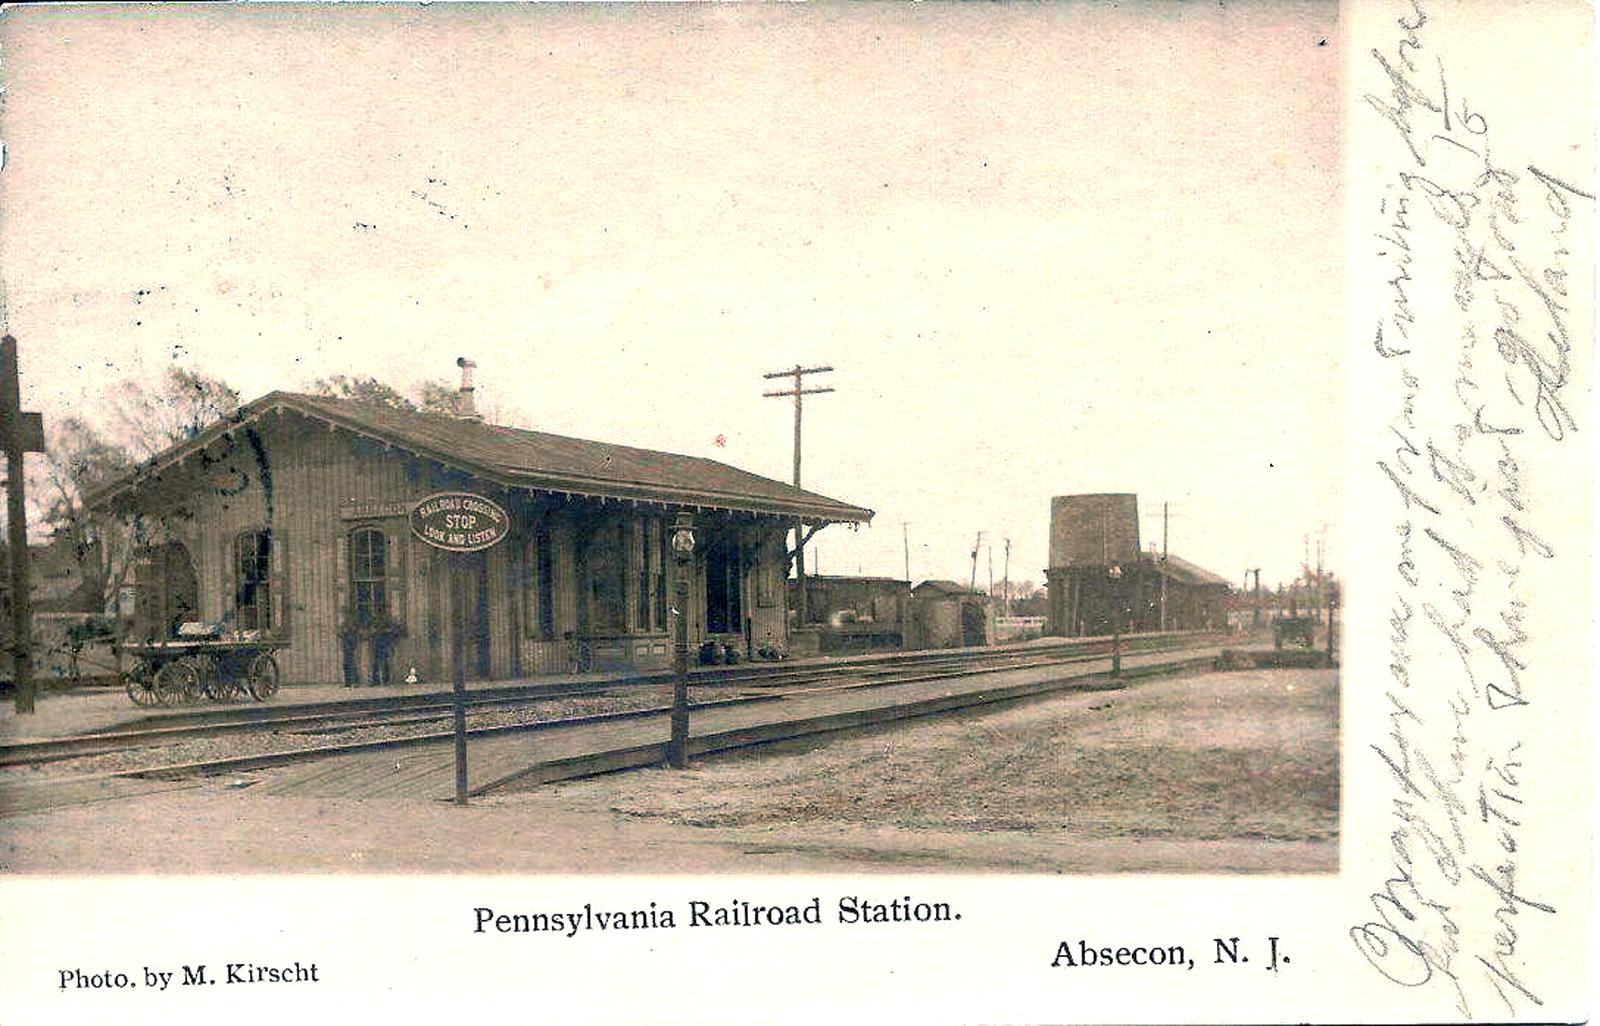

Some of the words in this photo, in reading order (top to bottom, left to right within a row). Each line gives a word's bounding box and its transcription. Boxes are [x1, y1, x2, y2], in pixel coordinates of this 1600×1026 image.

[1375, 424, 1441, 514] for
[418, 498, 462, 519] RAILROAD
[445, 514, 477, 529] STOP
[424, 524, 445, 542] LOOK
[447, 532, 466, 545] AND
[467, 526, 497, 545] LISTEN
